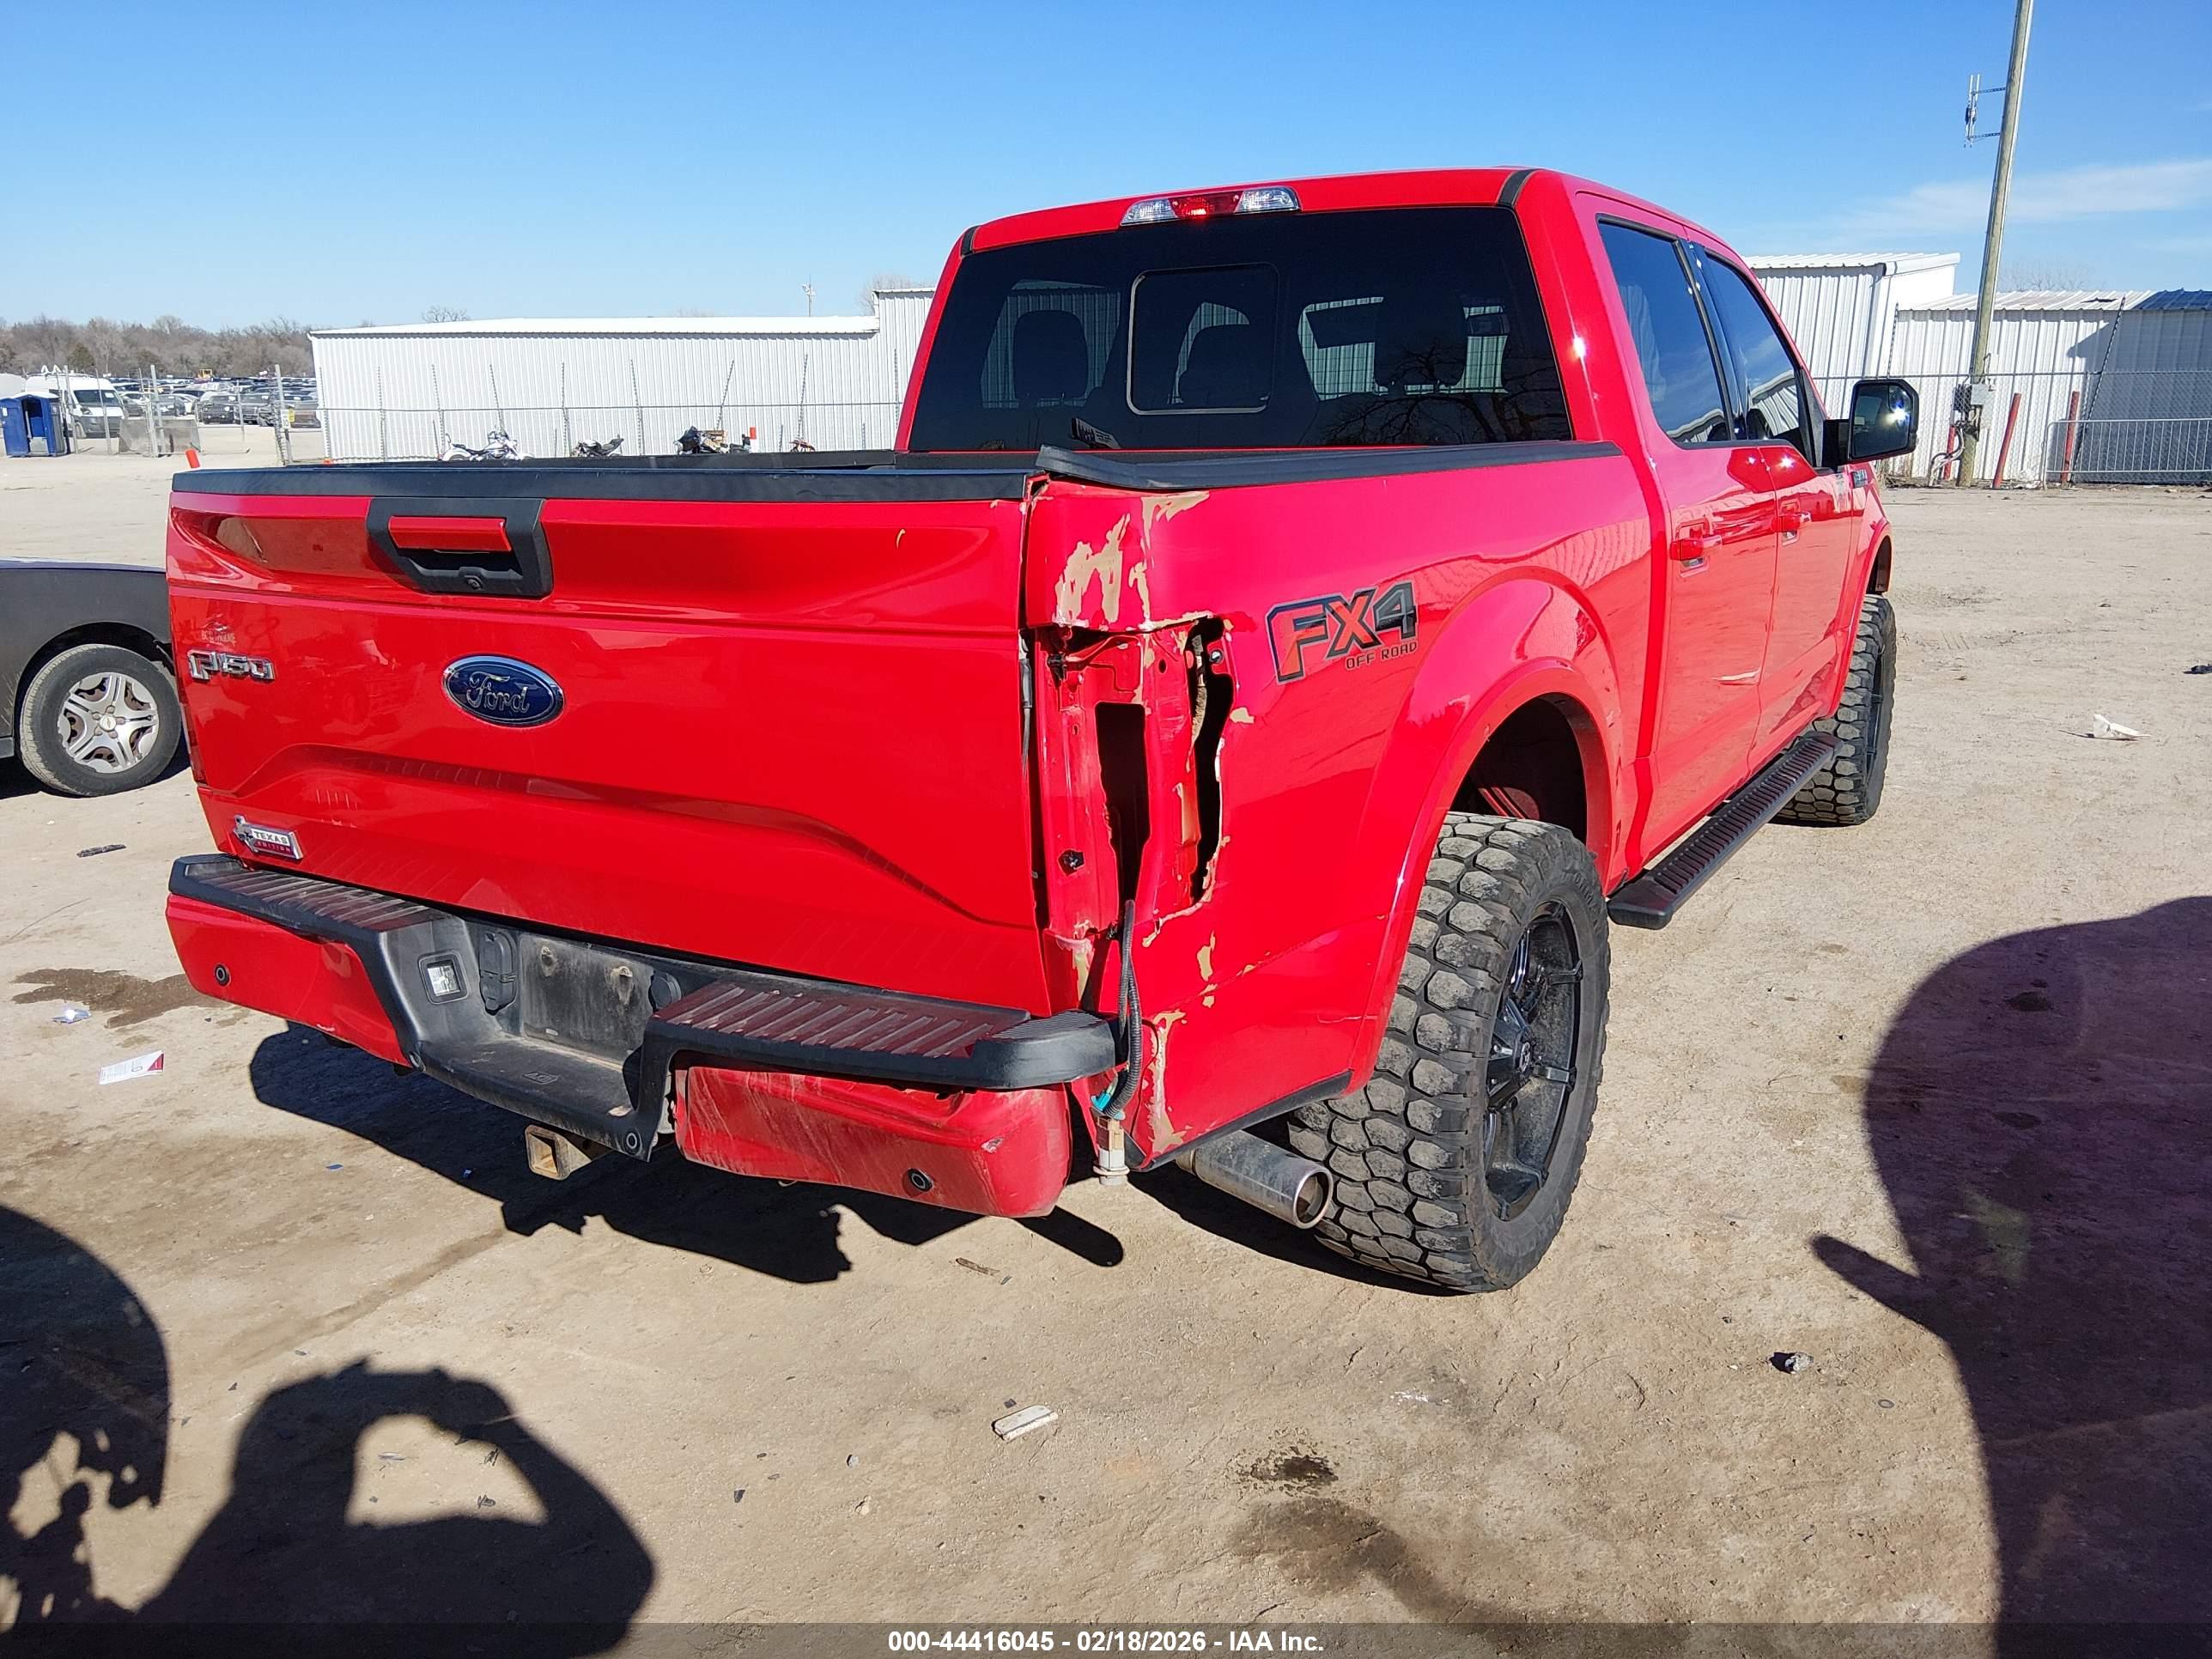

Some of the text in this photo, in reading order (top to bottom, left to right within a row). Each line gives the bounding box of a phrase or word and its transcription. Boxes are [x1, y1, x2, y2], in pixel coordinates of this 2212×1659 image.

[1266, 580, 1418, 685] FX4
[1346, 641, 1418, 671] OFF ROAD
[466, 671, 530, 714] Ford
[253, 830, 289, 844] TEXAS
[257, 841, 291, 853] EDITION
